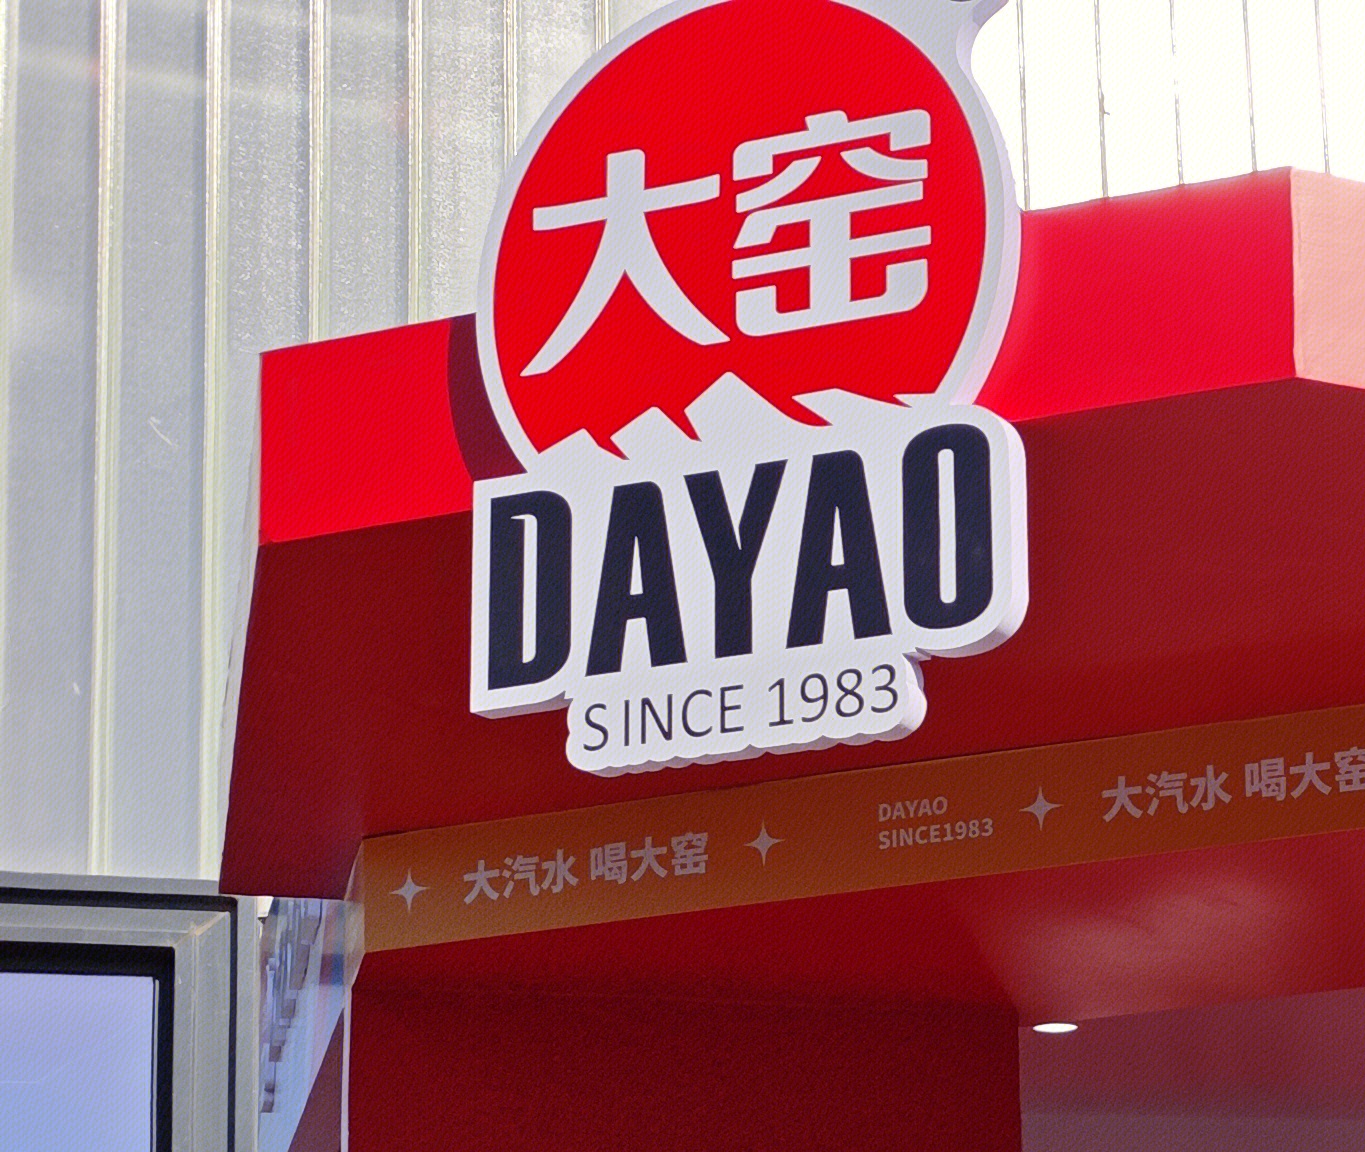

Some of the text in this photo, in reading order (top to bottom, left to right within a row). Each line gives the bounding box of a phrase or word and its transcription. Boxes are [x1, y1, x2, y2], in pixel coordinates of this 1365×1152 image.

[520, 109, 932, 377] 大窑
[488, 423, 994, 691] DAYAO
[583, 664, 901, 752] SINCE 1983
[877, 795, 949, 823] DAYAO
[1101, 765, 1233, 823] 大汽水
[462, 831, 710, 905] 大汽水 喝大窑
[877, 817, 995, 851] SINCE1983
